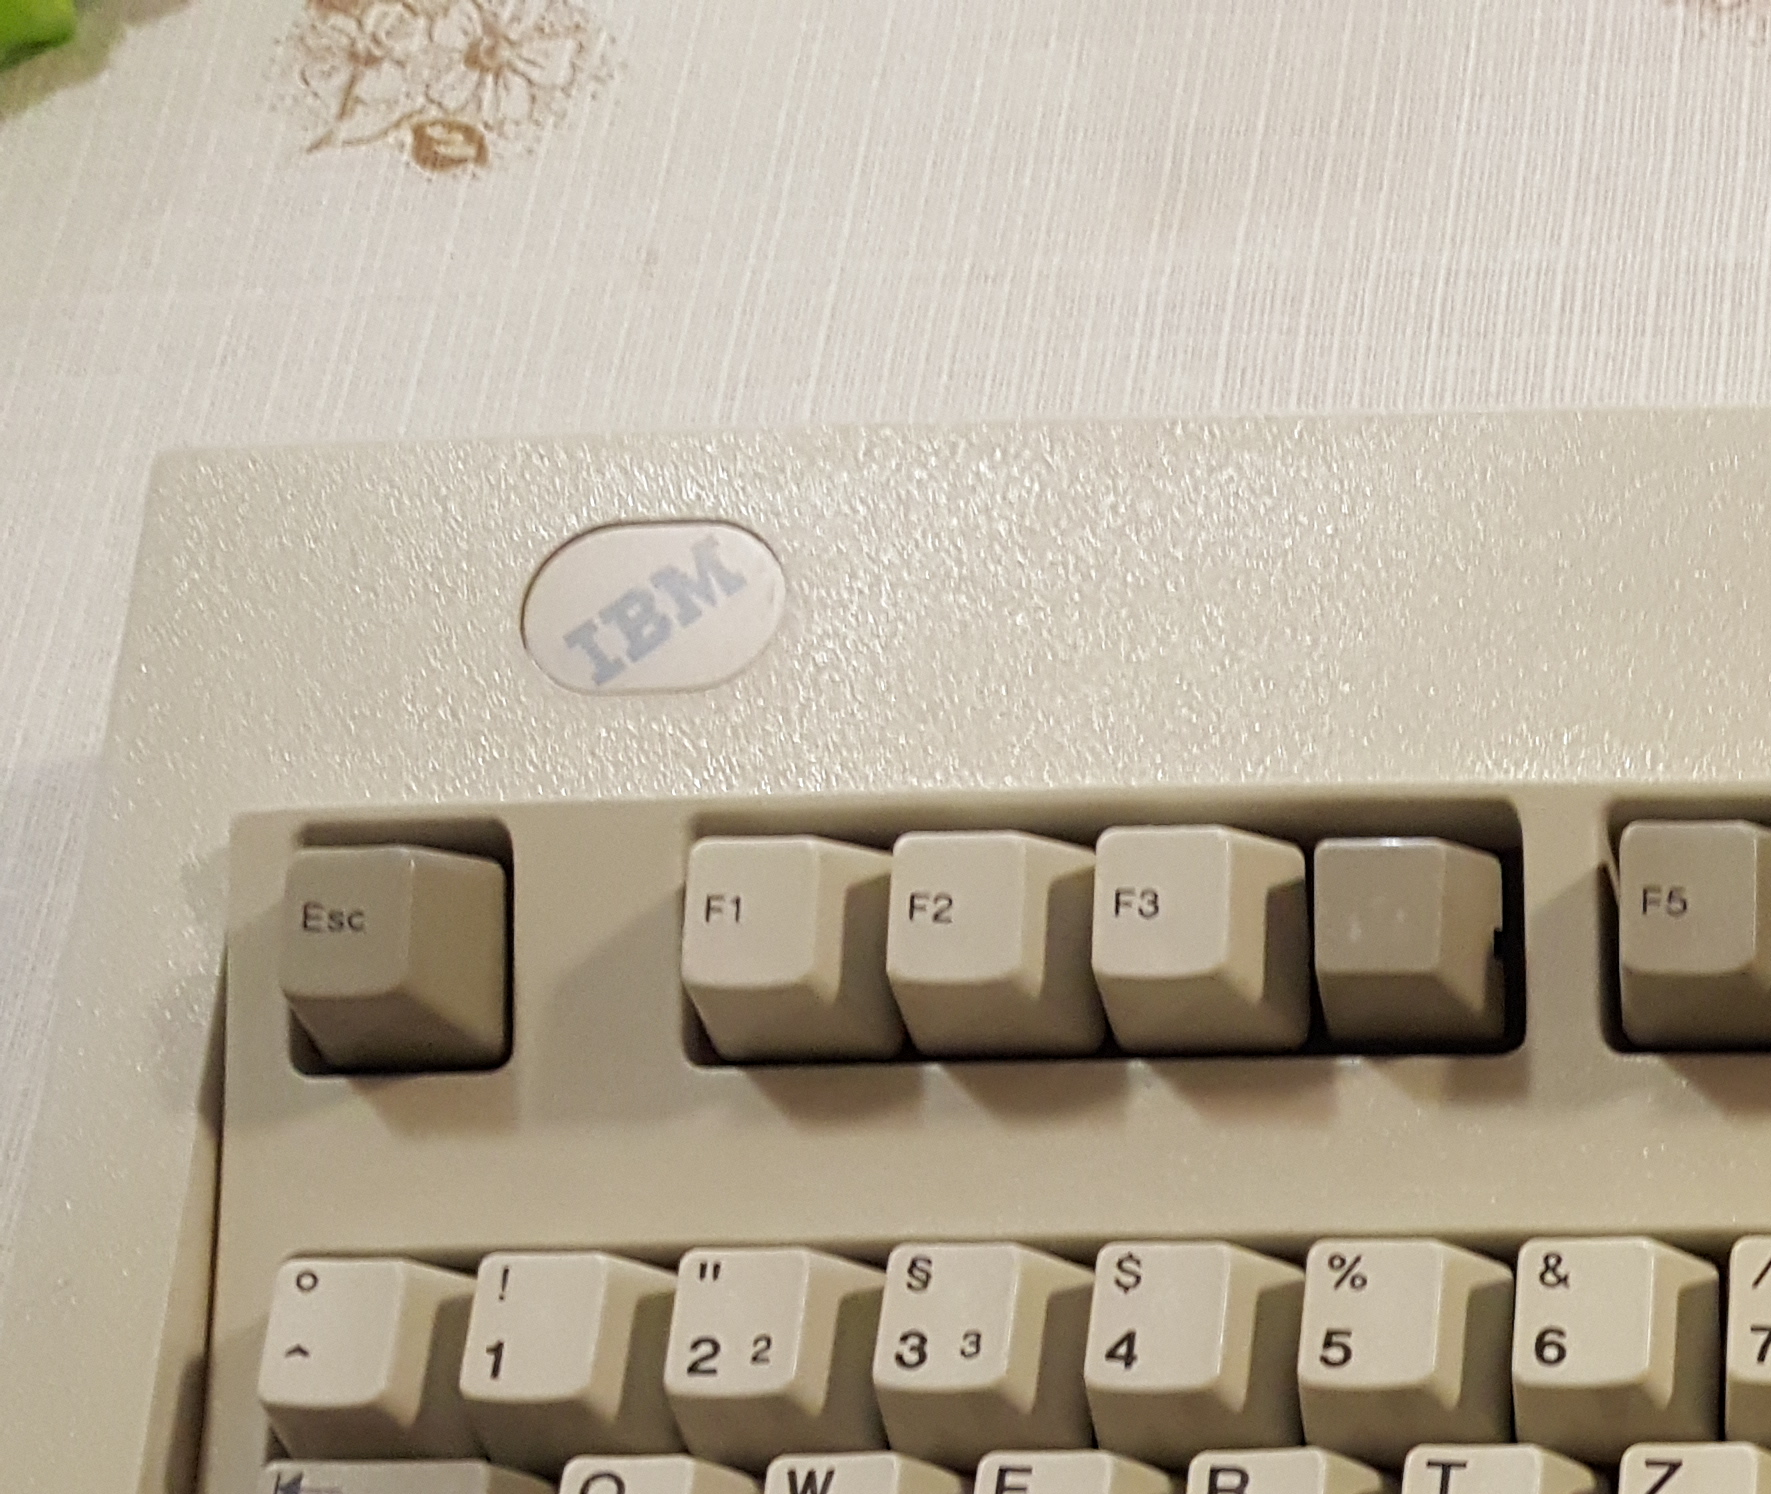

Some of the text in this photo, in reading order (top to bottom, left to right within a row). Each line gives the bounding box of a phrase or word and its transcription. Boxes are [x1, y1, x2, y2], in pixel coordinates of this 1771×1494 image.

[563, 535, 747, 687] IBM
[300, 900, 365, 934] Esc
[704, 894, 742, 924] F1
[908, 892, 954, 924] F2
[1113, 888, 1160, 920] F3
[1641, 885, 1689, 918] F5
[485, 1340, 505, 1380] 1
[686, 1335, 721, 1376] 2
[894, 1330, 928, 1371] 3
[1104, 1330, 1138, 1370] 4
[1319, 1328, 1353, 1369] 5
[1534, 1326, 1567, 1367] 6
